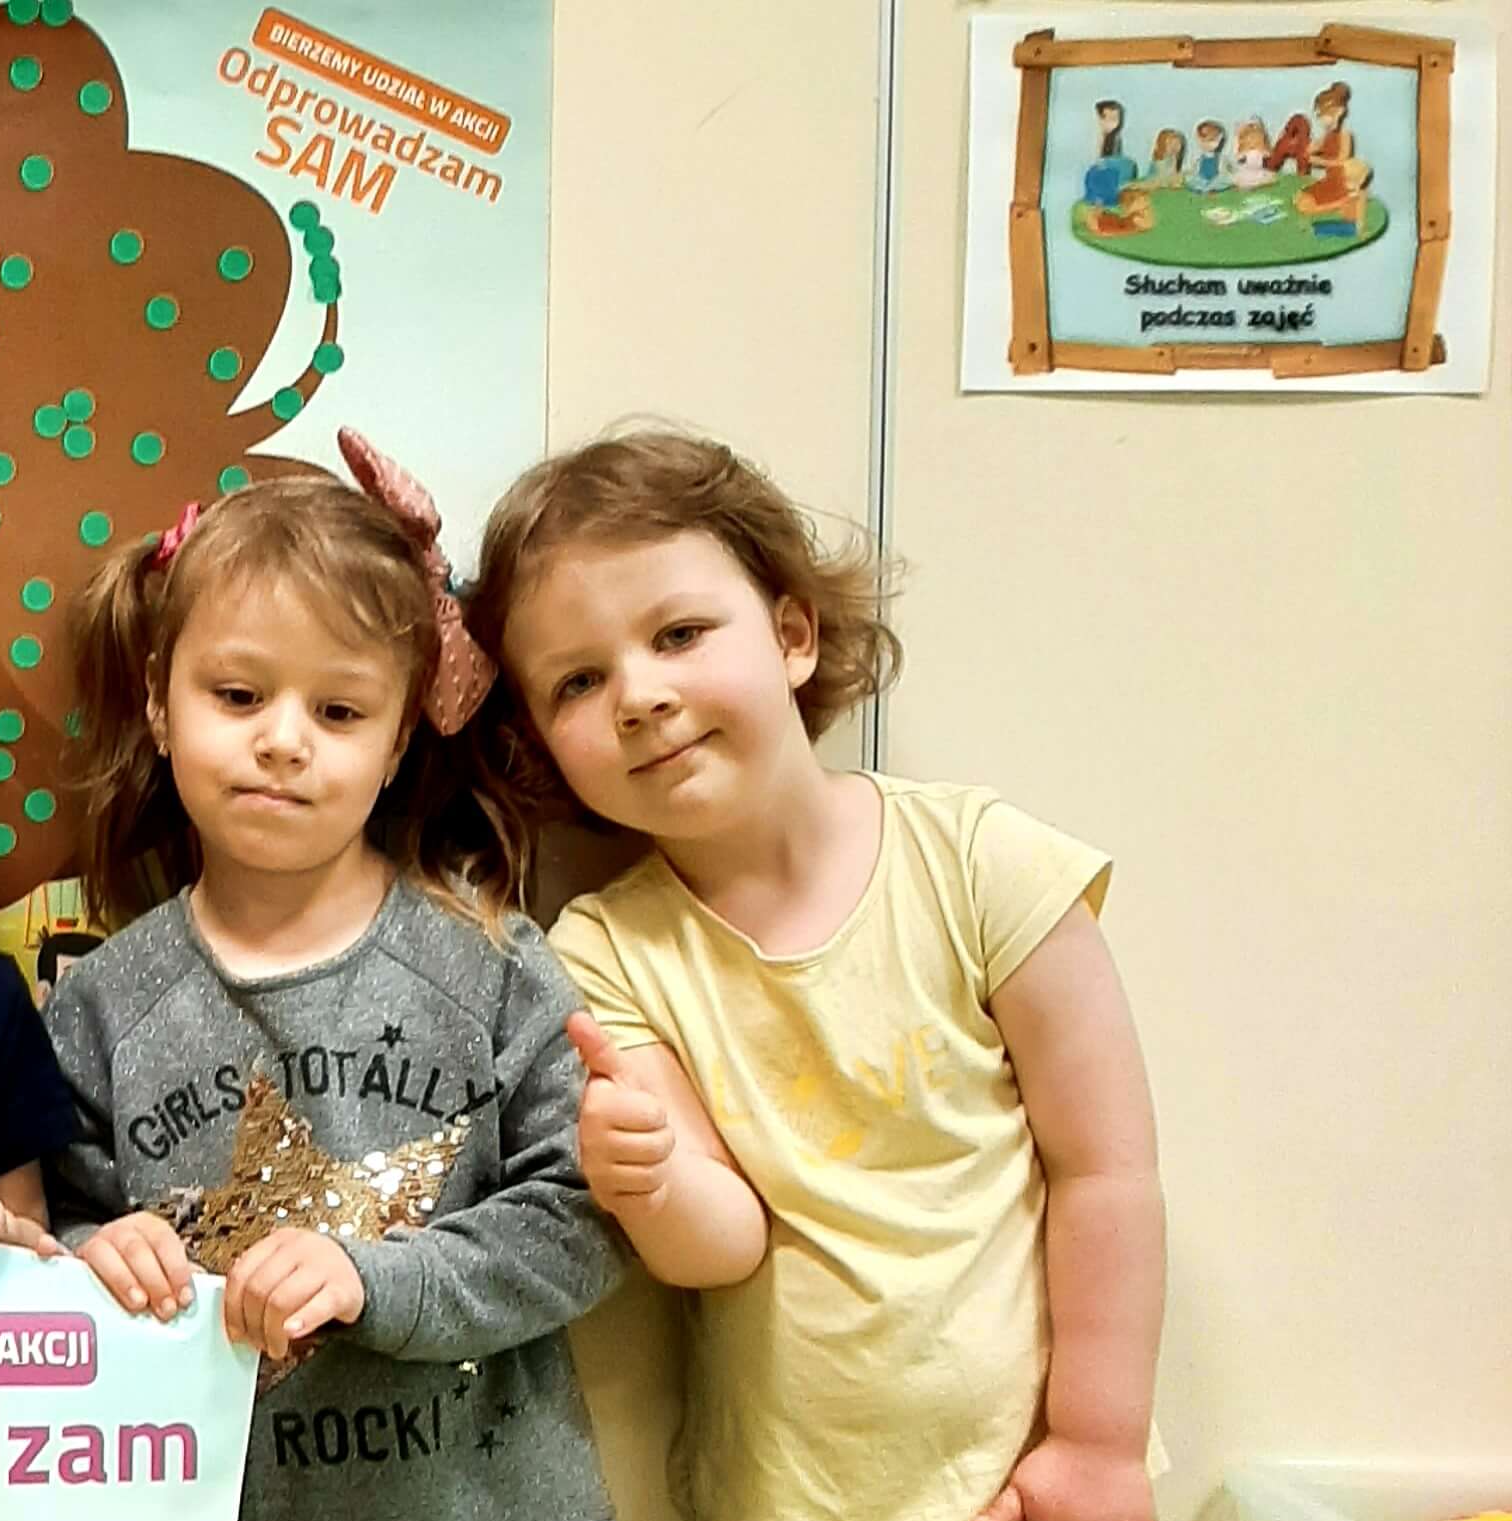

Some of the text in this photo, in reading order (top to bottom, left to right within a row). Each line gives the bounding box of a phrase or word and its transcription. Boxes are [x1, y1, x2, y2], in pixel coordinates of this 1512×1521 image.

[270, 22, 501, 144] BIERZEMY UDZIAŁ W AKCJI
[218, 46, 504, 203] Odprowadzam
[255, 114, 399, 216] SAM
[1123, 272, 1333, 296] Słucham uważnie
[1141, 302, 1316, 333] podczas zajęć
[274, 1044, 506, 1125] TOTALLY
[271, 1393, 443, 1469] ROCK!
